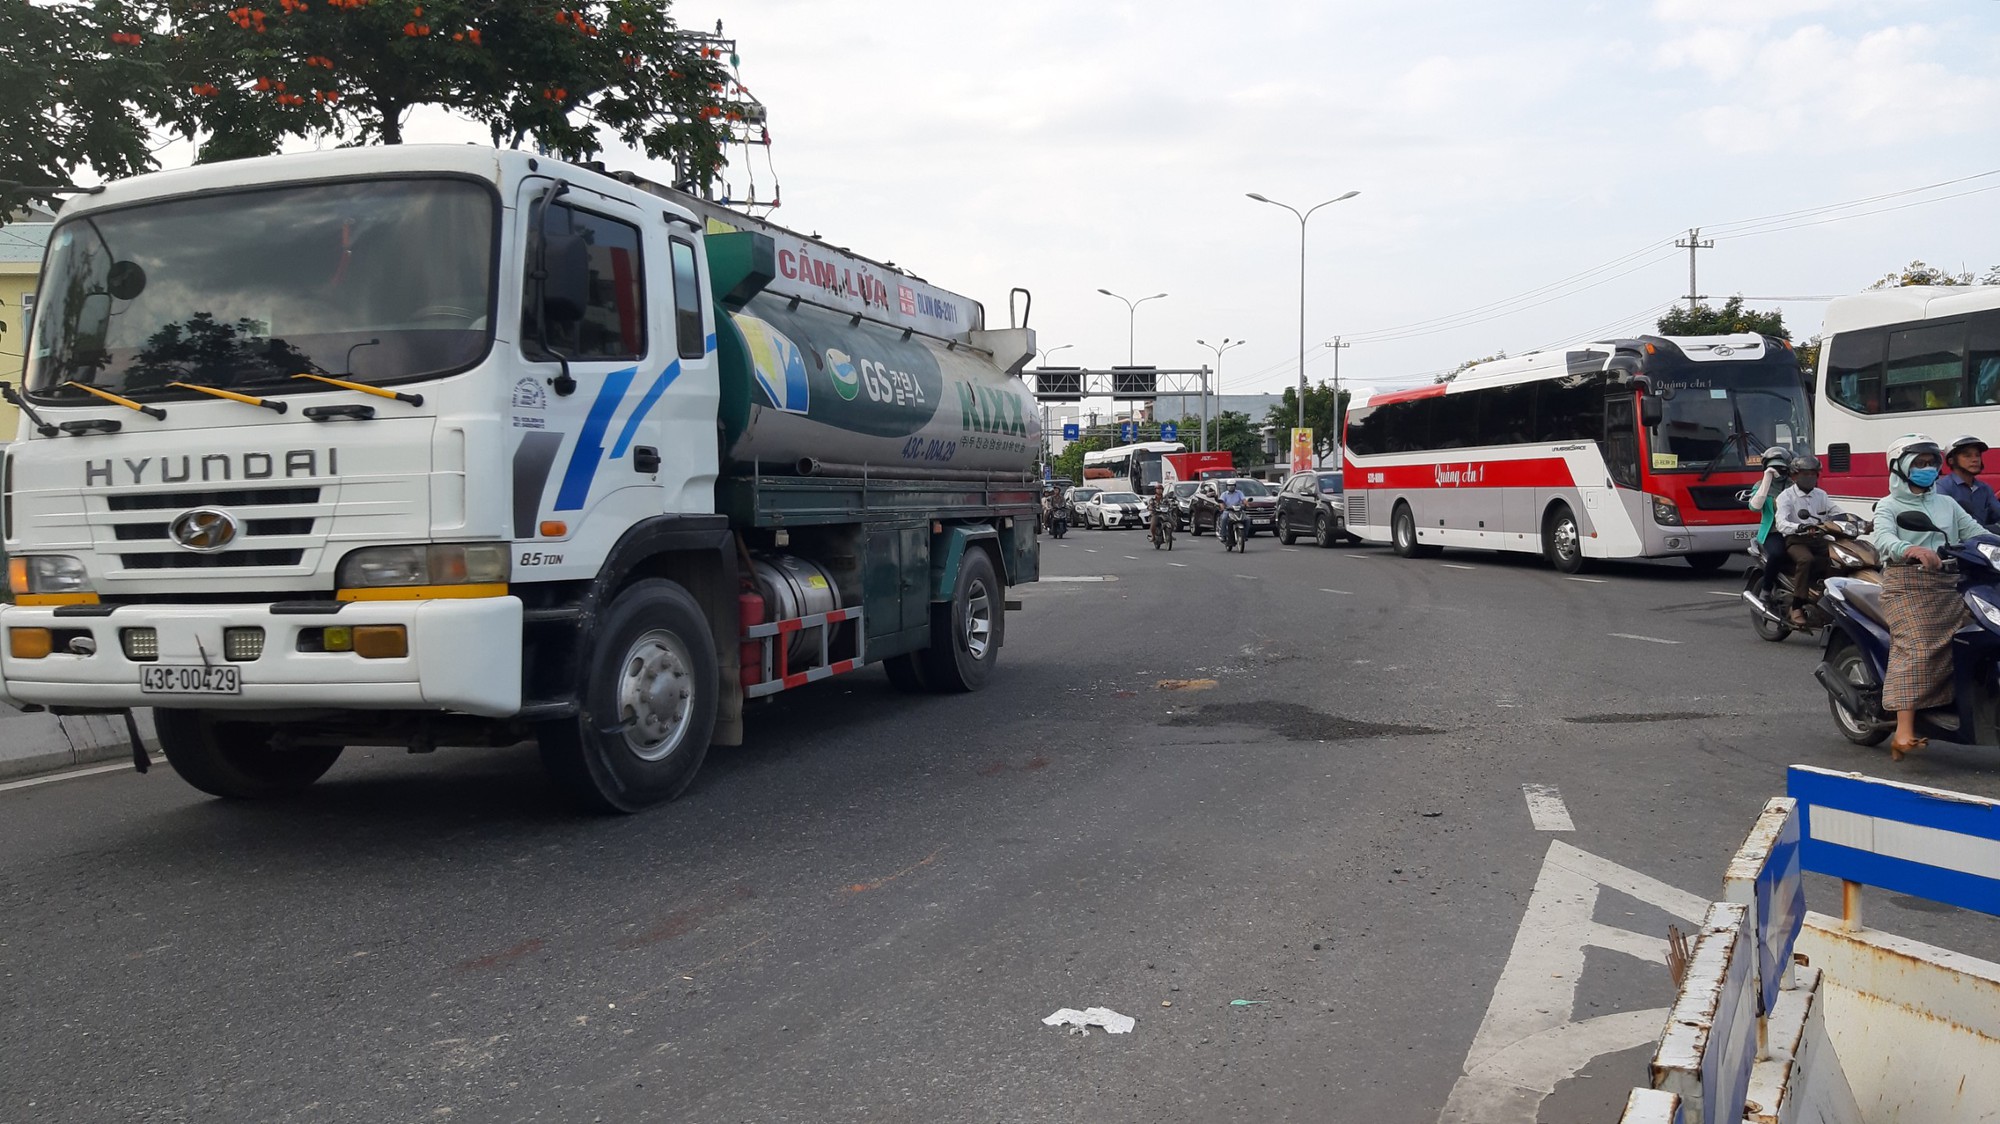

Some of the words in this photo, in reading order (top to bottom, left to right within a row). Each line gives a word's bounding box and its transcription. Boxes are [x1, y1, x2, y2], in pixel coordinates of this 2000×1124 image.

[860, 358, 893, 404] GS
[889, 370, 926, 408] 칼텍스
[86, 447, 338, 487] HYUNDAI
[1479, 463, 1485, 482] 1
[543, 554, 564, 565] TON
